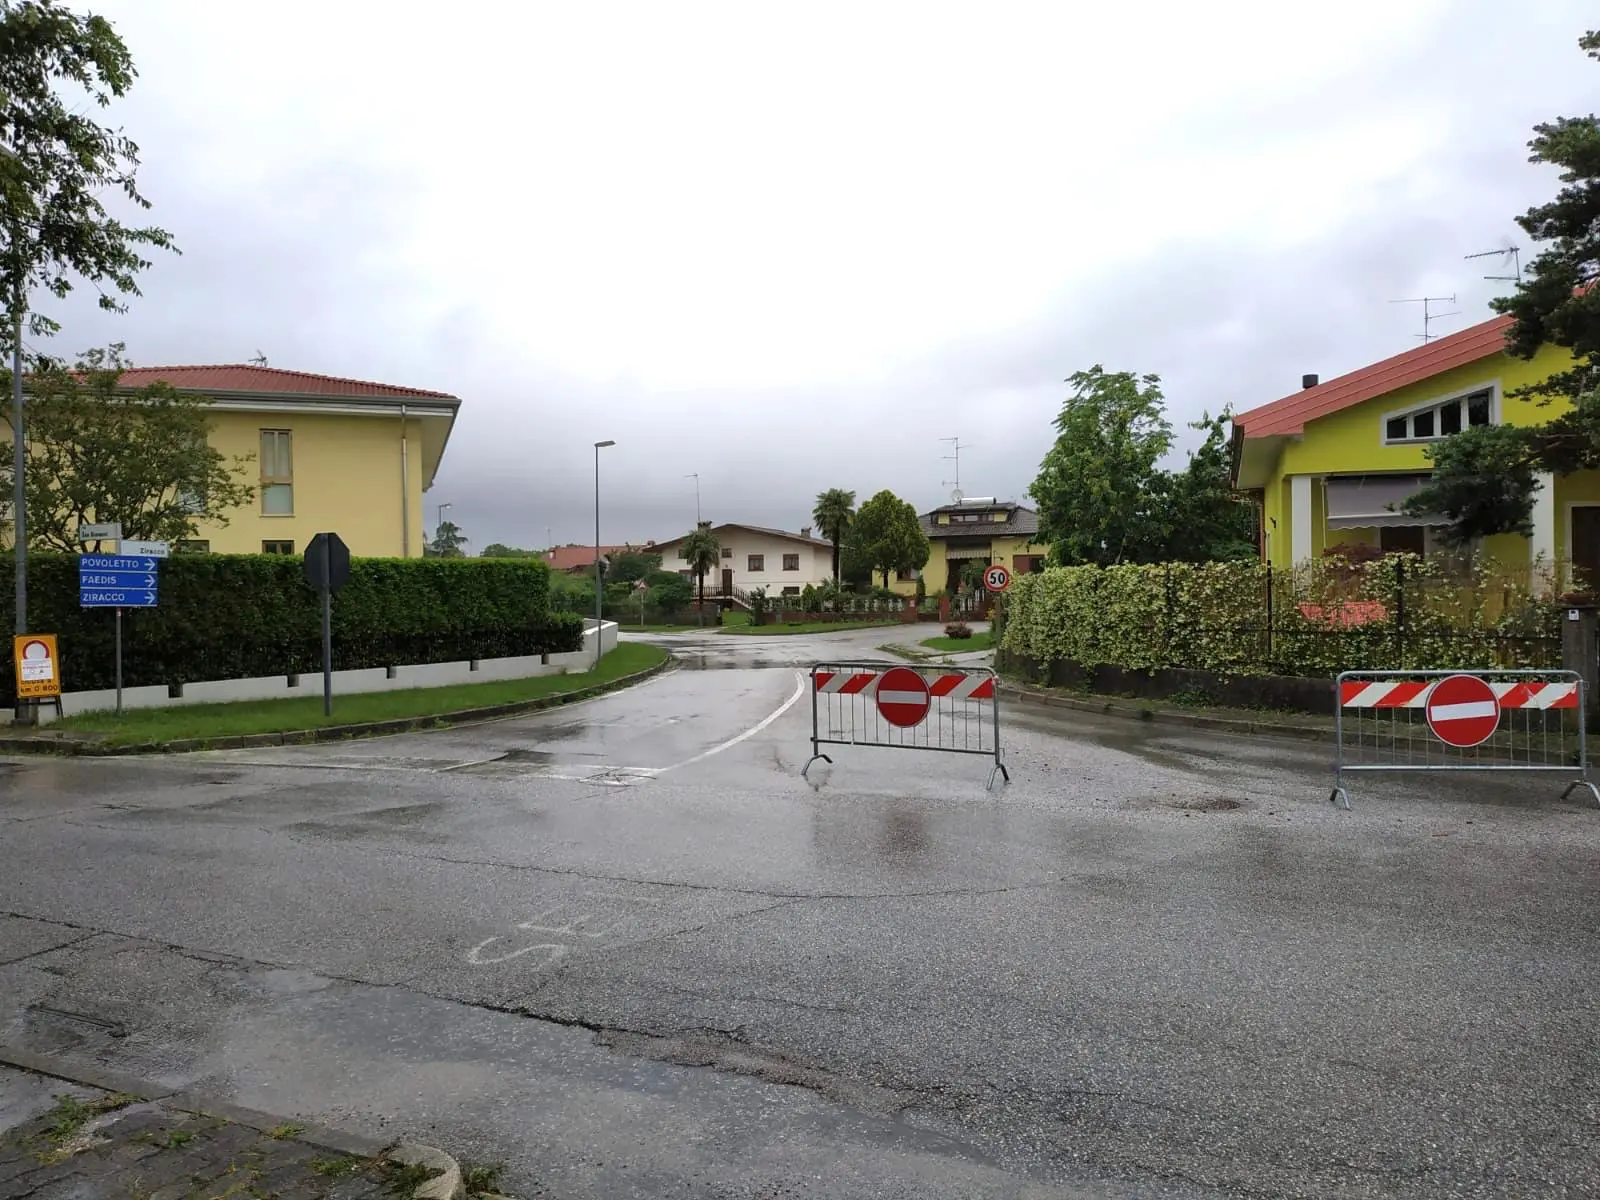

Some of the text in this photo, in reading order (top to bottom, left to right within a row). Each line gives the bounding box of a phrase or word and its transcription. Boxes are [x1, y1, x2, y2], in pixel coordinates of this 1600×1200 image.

[81, 558, 139, 568] POVOLETTO
[81, 575, 117, 584] FAEDIS
[990, 572, 1005, 584] 50
[82, 593, 125, 602] ZIRACCO
